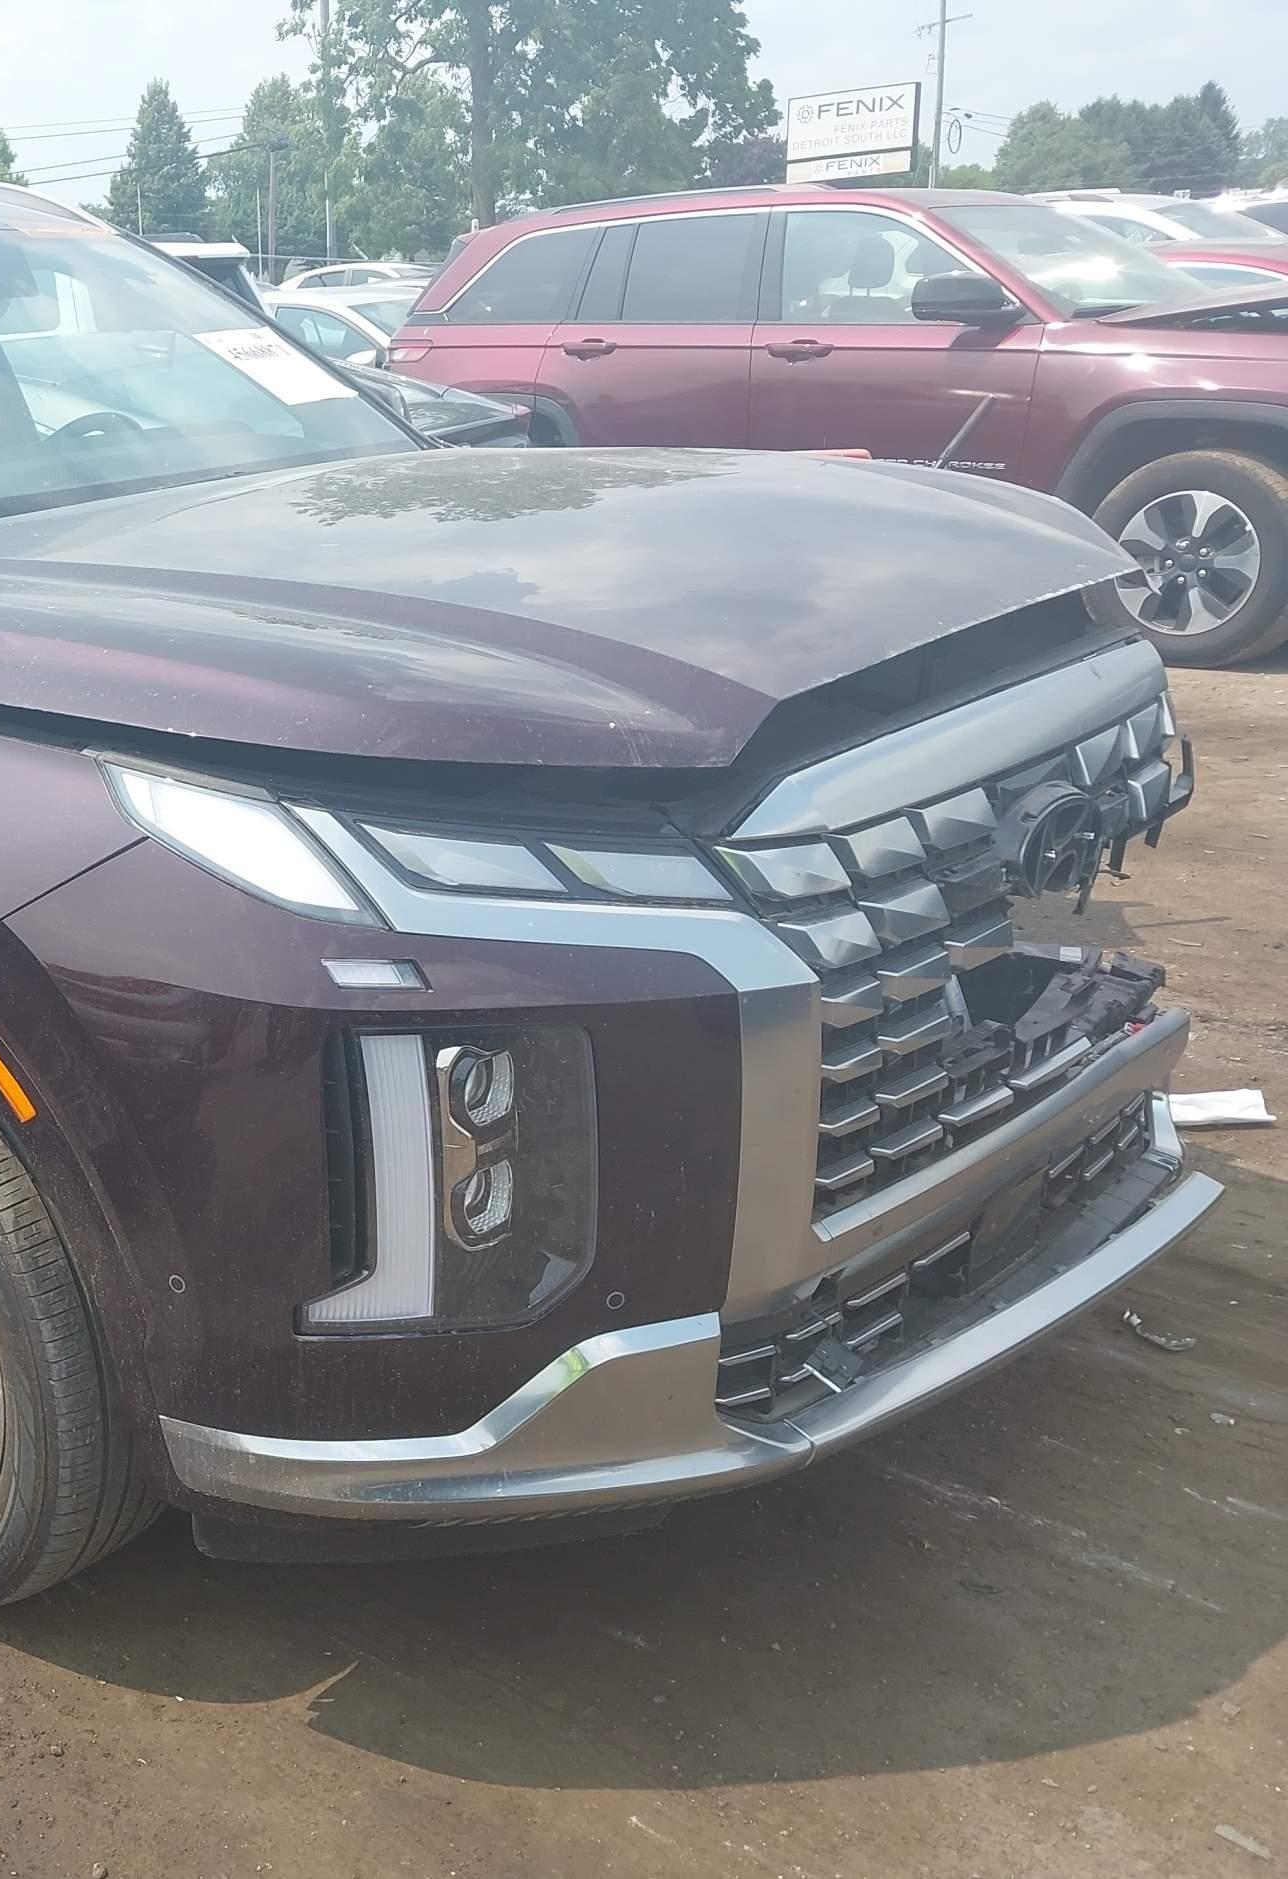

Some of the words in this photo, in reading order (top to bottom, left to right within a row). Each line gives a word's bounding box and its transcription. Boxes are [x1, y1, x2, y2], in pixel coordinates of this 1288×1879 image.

[818, 94, 904, 119] FENIX
[834, 121, 866, 134] FENIX
[871, 118, 908, 130] PARTS
[793, 138, 839, 151] DETROIT
[844, 133, 882, 145] SOUTH
[887, 129, 907, 138] LLC
[826, 156, 880, 171] FENIX
